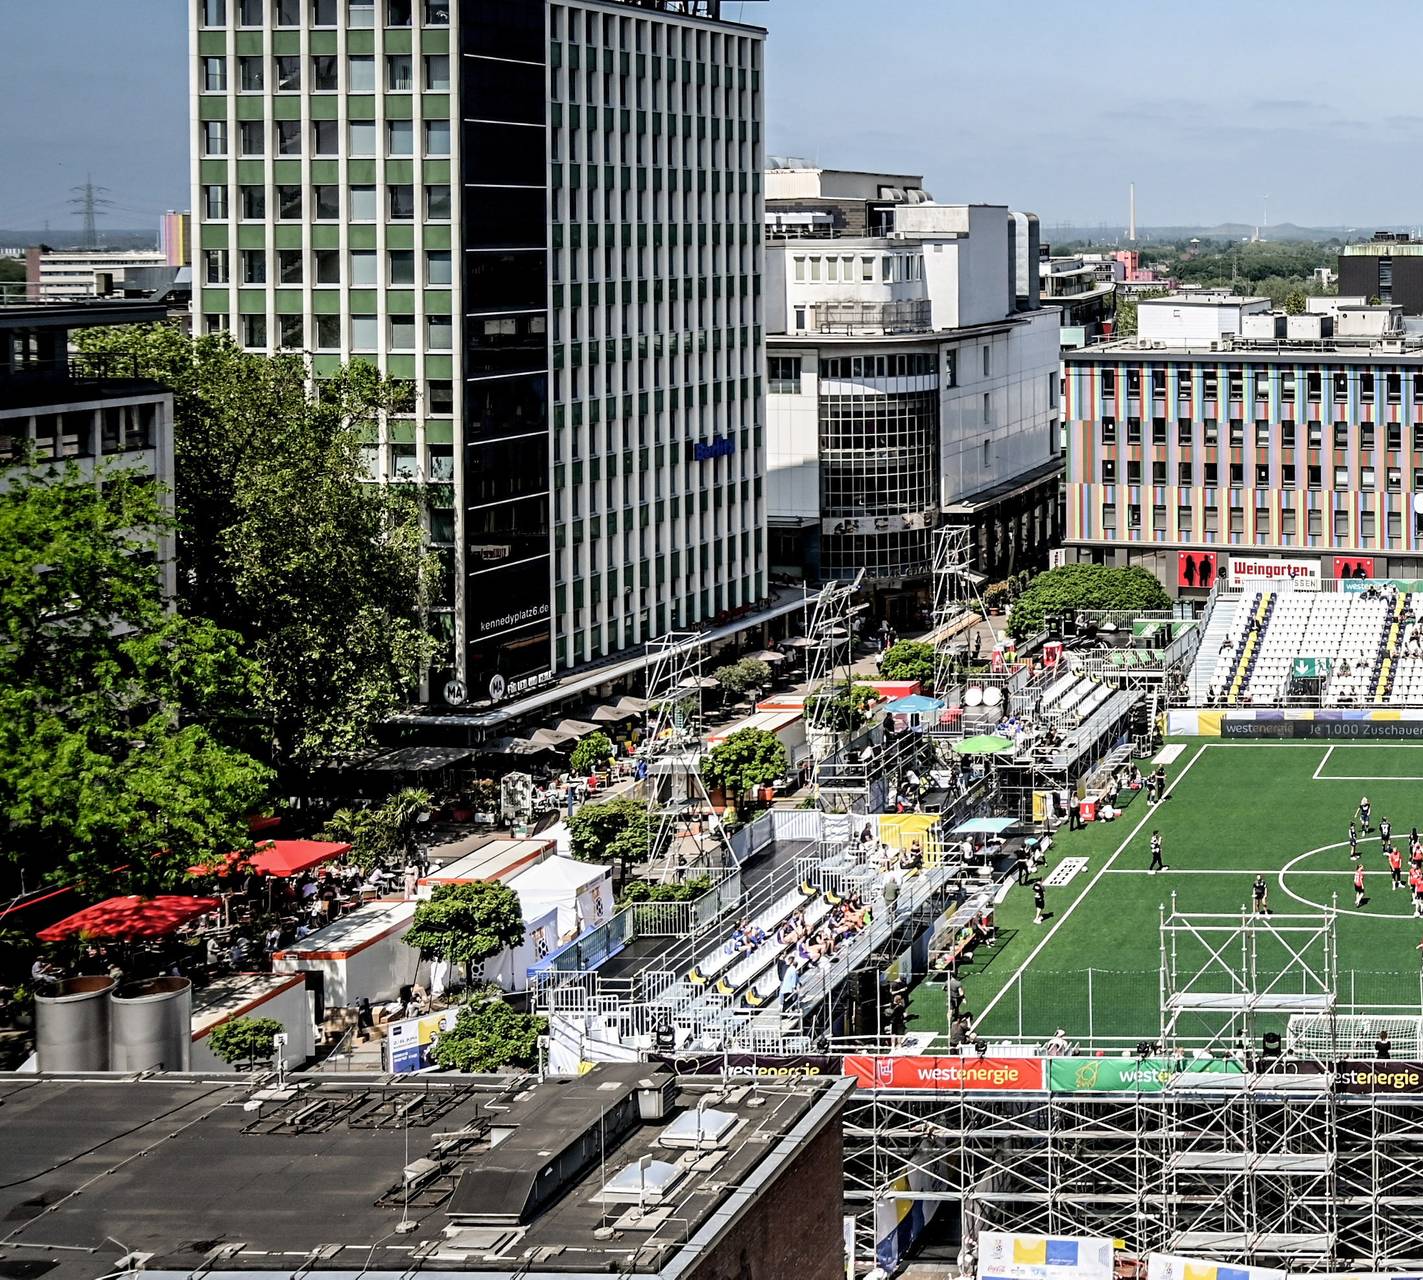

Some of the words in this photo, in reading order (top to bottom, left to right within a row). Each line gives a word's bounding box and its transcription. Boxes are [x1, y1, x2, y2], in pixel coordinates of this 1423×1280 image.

[1234, 562, 1308, 578] Weingarten
[1294, 579, 1316, 587] SSEN
[480, 603, 549, 631] kennedyplatz6.de
[447, 686, 463, 699] MA
[1226, 724, 1293, 736] westenergie
[1310, 725, 1324, 735] Je
[1326, 724, 1359, 735] 1.000
[918, 1065, 1019, 1083] westenergie
